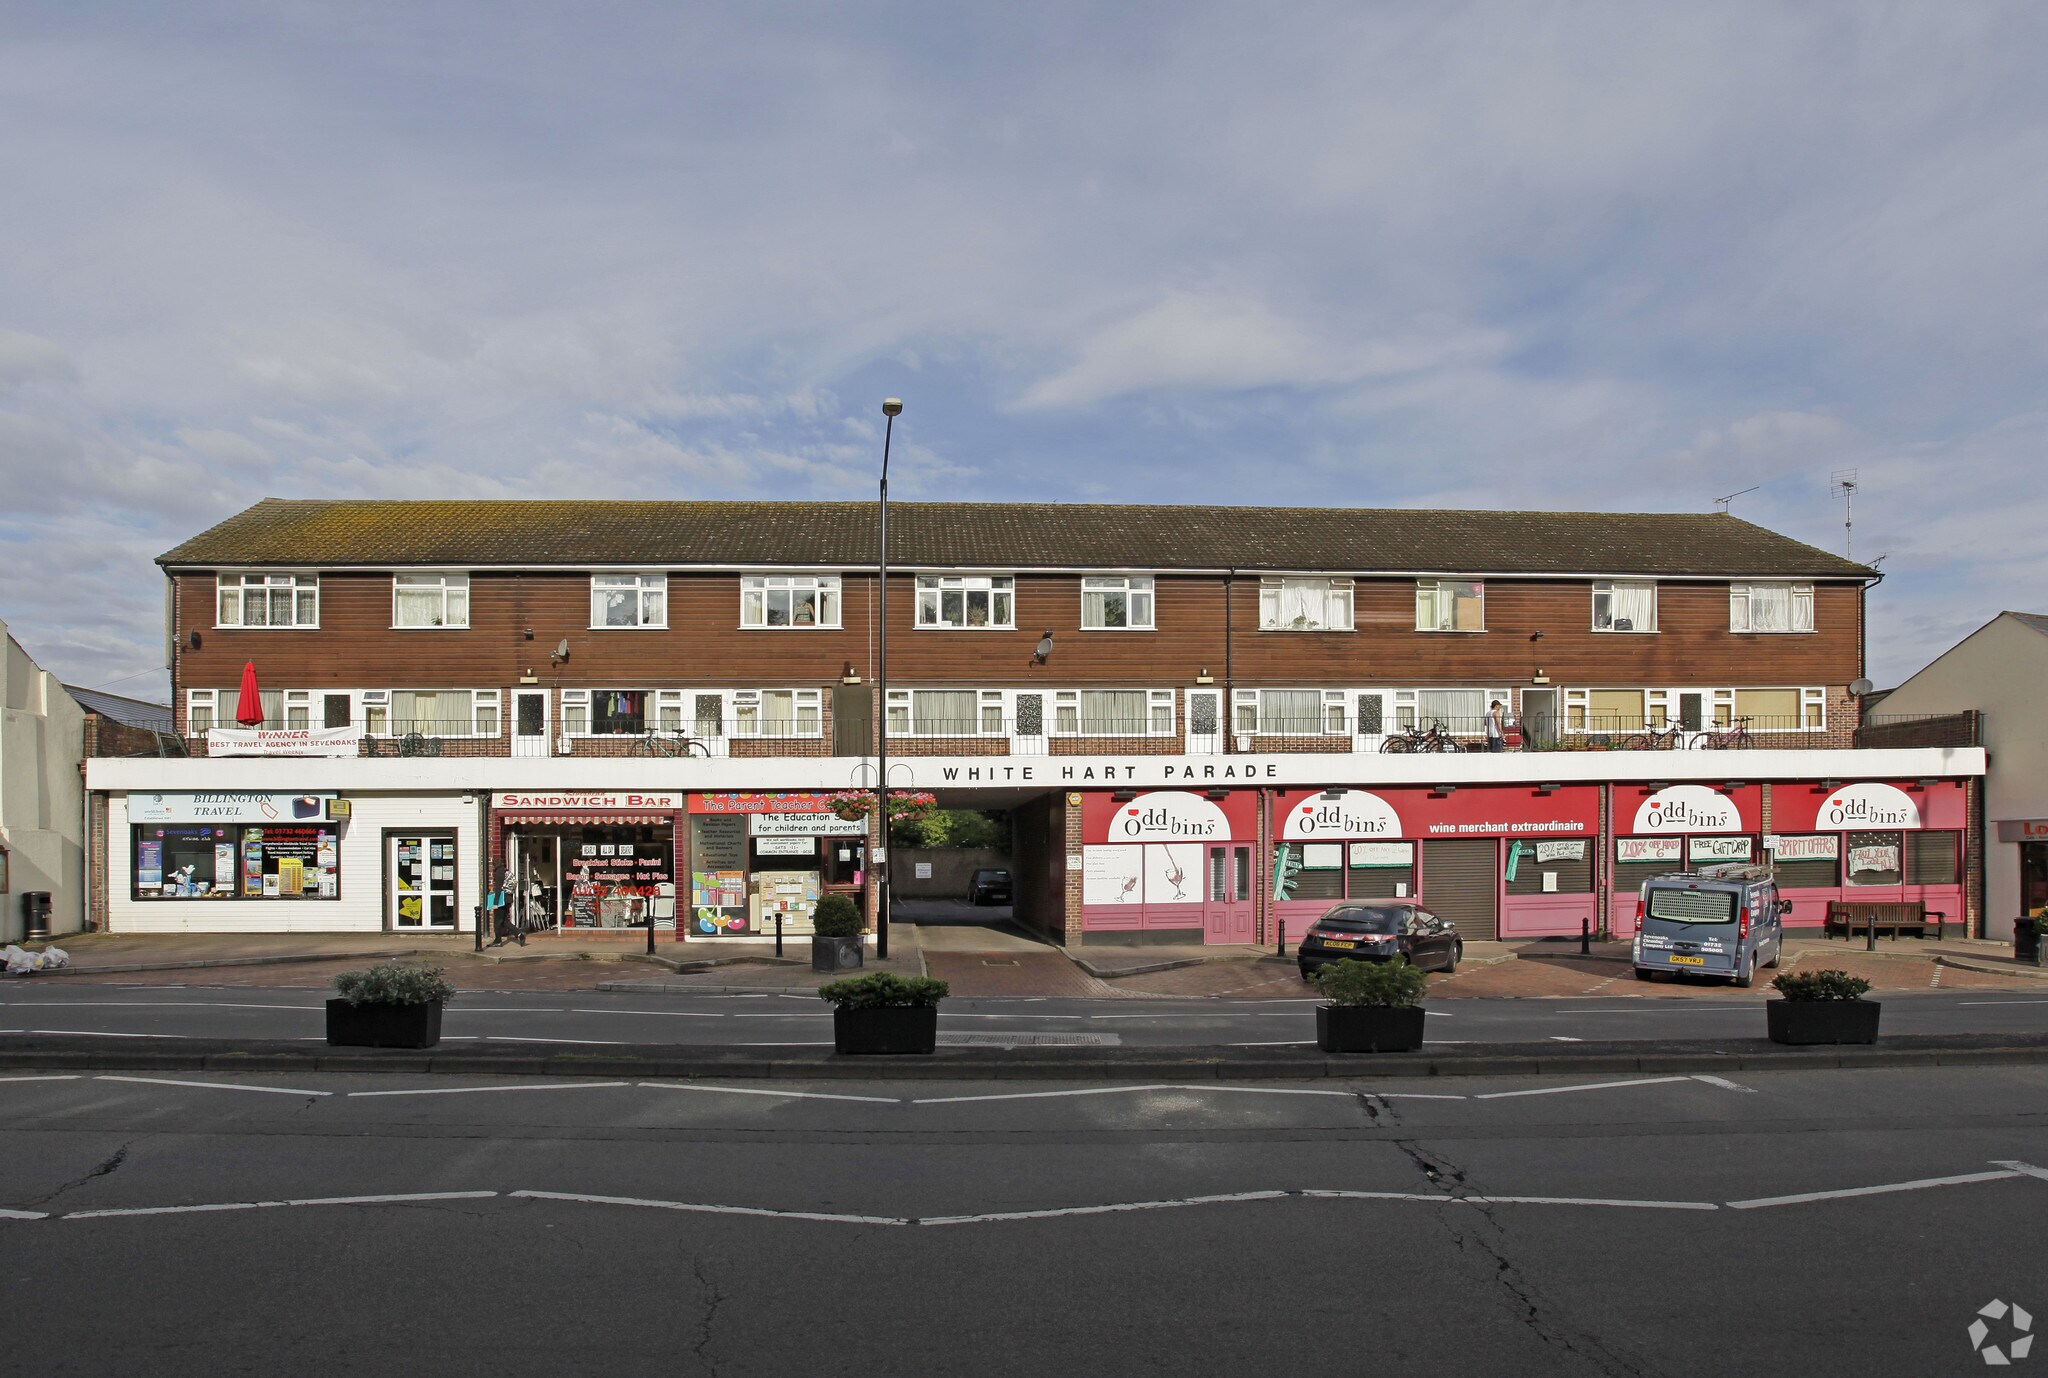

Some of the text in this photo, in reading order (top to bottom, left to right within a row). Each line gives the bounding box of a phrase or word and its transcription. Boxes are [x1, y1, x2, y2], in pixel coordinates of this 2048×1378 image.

[310, 739, 357, 747] SEVENOAKS
[943, 764, 1277, 781] WHITE HART PARADE
[193, 794, 274, 803] BILLINGTON
[703, 800, 725, 811] The
[727, 800, 765, 811] Parent
[770, 799, 814, 811] Teacher
[194, 807, 242, 816] TRAVEL
[761, 813, 781, 821] The
[783, 812, 830, 822] Education
[1647, 801, 1728, 828] Oddbins
[1830, 798, 1907, 826] Oddbins
[1124, 808, 1215, 837] Oddbins
[1299, 806, 1387, 834] Oddbins
[758, 823, 861, 834] for children and parents
[1429, 820, 1584, 833] wine merchant extraordinaire
[1538, 843, 1555, 853] 20%
[1621, 840, 1647, 858] 20%
[1649, 840, 1661, 849] OFF
[1693, 840, 1712, 849] FREE
[572, 858, 662, 867] Breakfast Sticks Panini
[594, 872, 631, 882] Sausages
[636, 872, 651, 880] Hot
[651, 872, 669, 880] Pies
